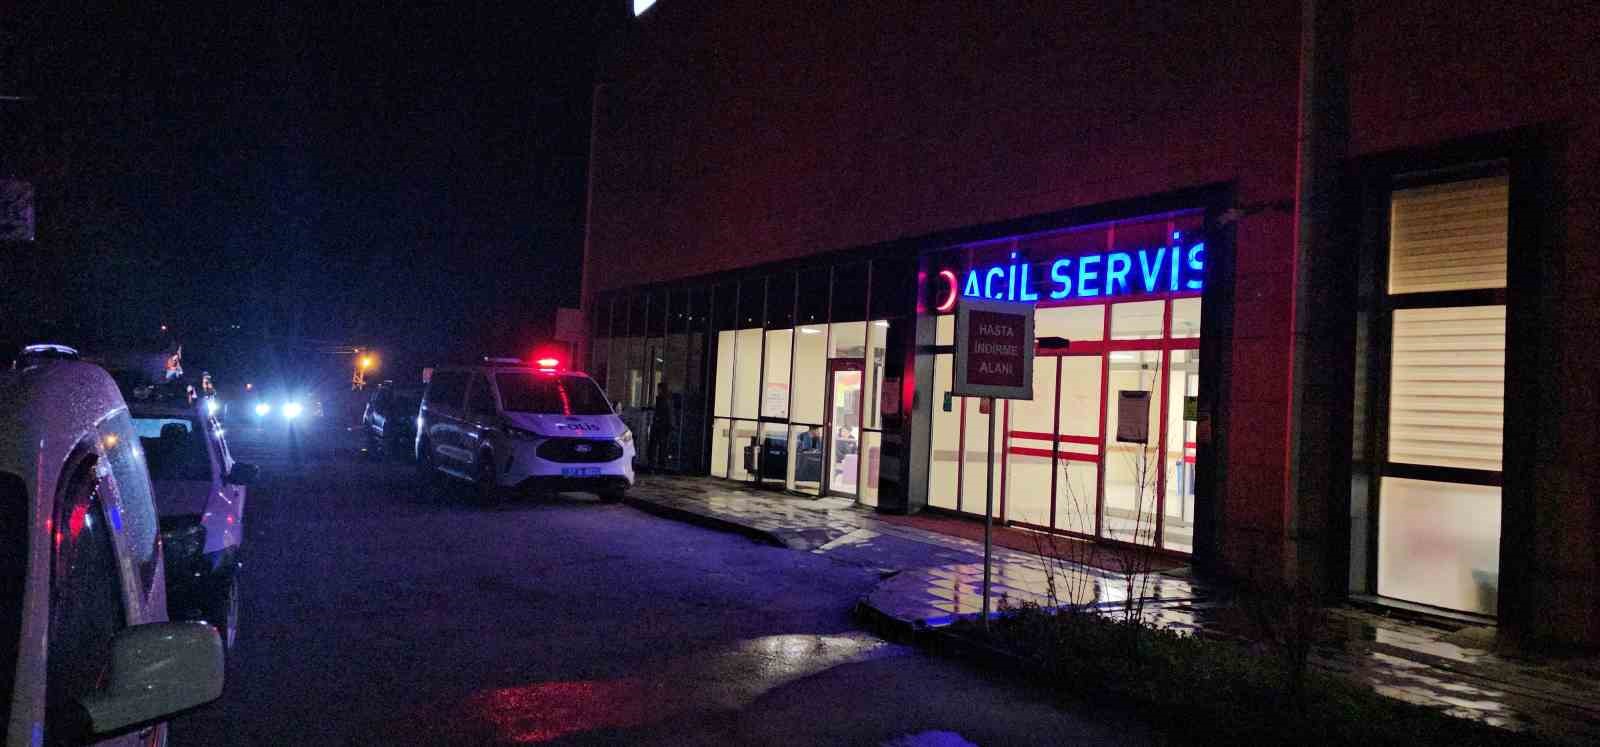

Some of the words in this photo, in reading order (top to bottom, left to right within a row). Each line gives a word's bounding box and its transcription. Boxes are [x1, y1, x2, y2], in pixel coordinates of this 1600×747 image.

[964, 252, 1038, 301] ACİL
[1050, 232, 1204, 299] SERVİS
[979, 323, 1014, 337] HASTA
[979, 361, 1014, 376] ALANI
